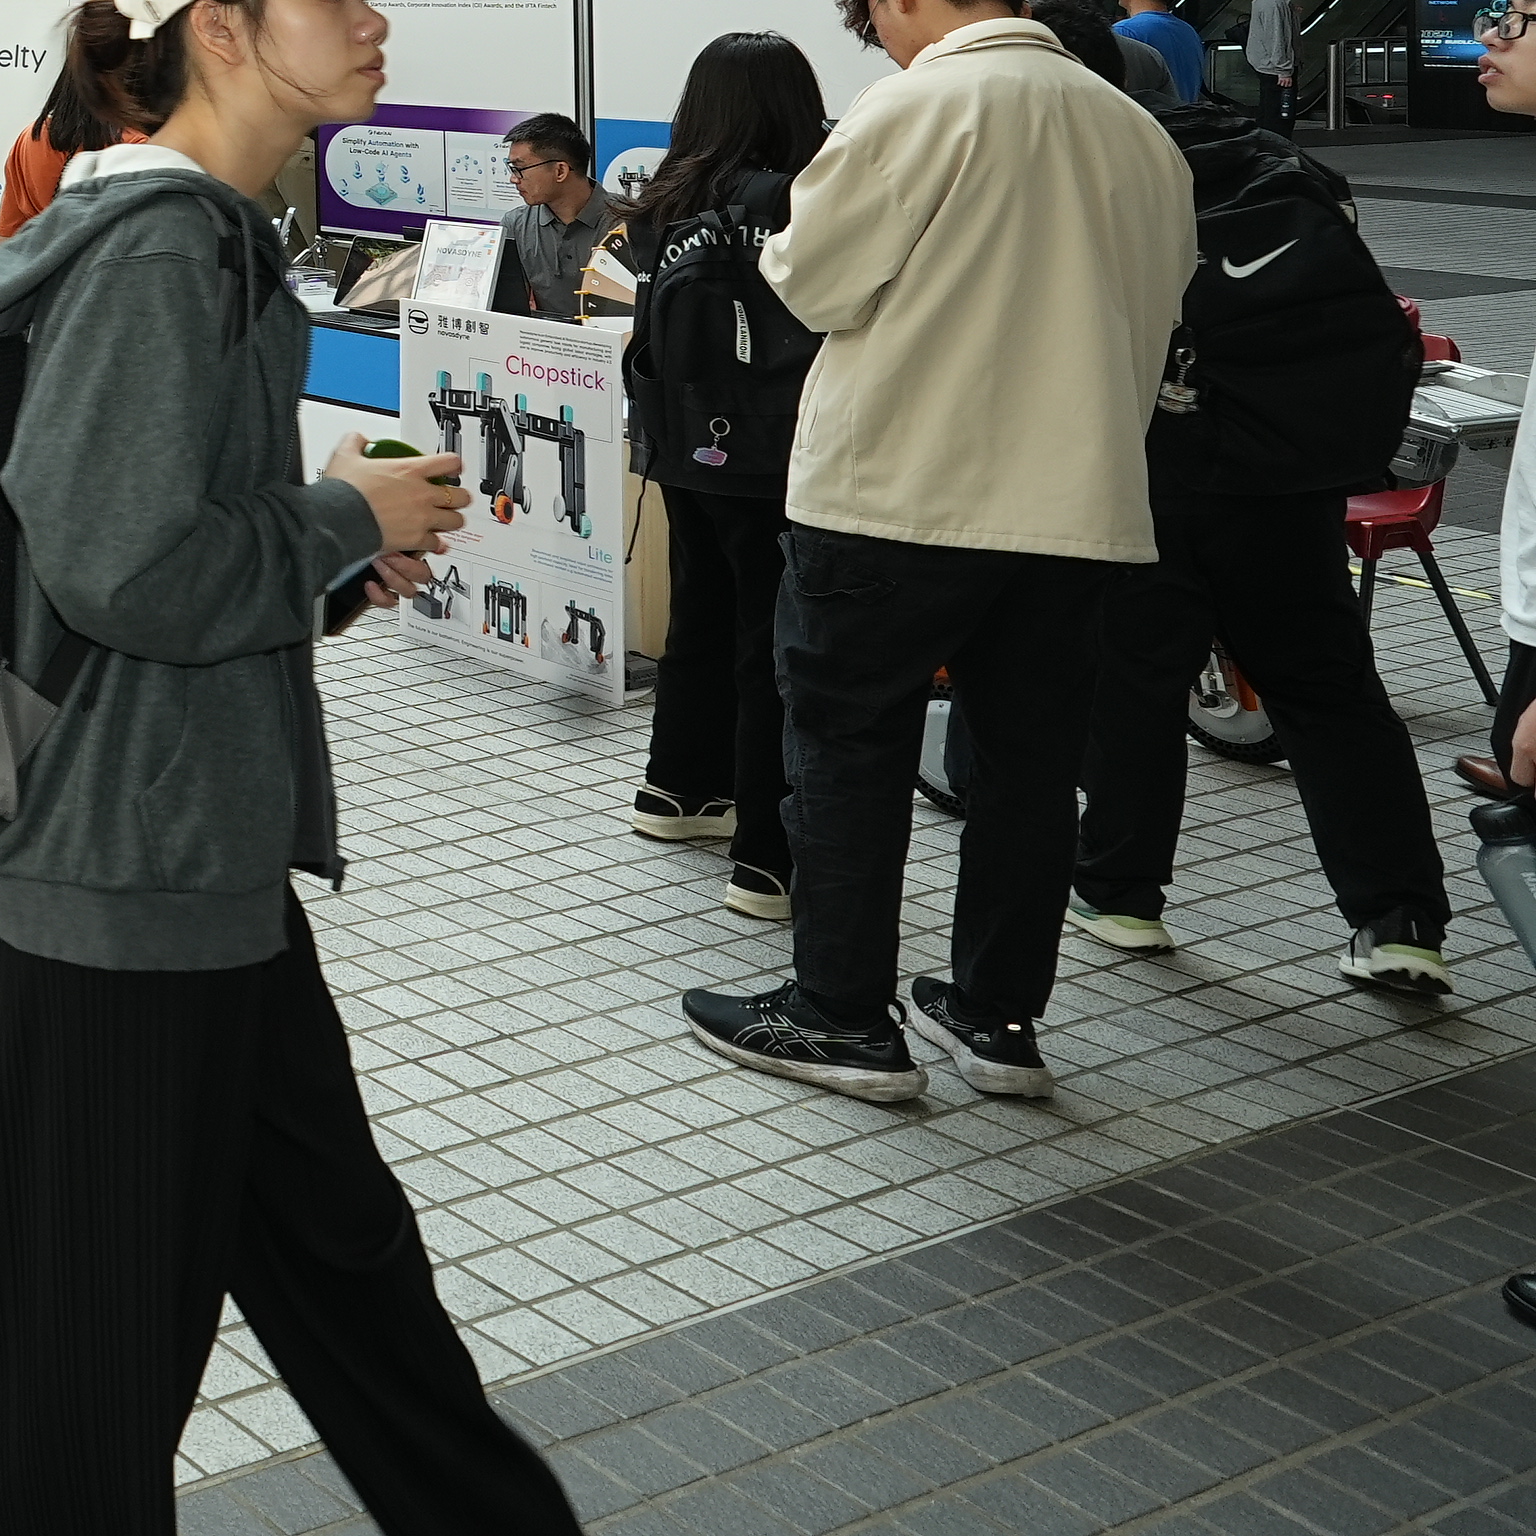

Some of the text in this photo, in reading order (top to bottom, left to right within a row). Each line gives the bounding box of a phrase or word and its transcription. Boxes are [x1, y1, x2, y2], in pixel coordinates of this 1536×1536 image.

[342, 137, 367, 147] Simplify
[367, 139, 404, 149] Automation
[349, 147, 380, 156] Low-Code
[611, 239, 623, 251] 10
[436, 247, 483, 258] NOVASDYNE
[592, 278, 600, 286] 8
[738, 304, 747, 324] YOUR
[437, 314, 490, 336] 雅博創智
[437, 330, 471, 341] novasdyne
[505, 355, 606, 392] Chopstick
[588, 545, 613, 564] Lite
